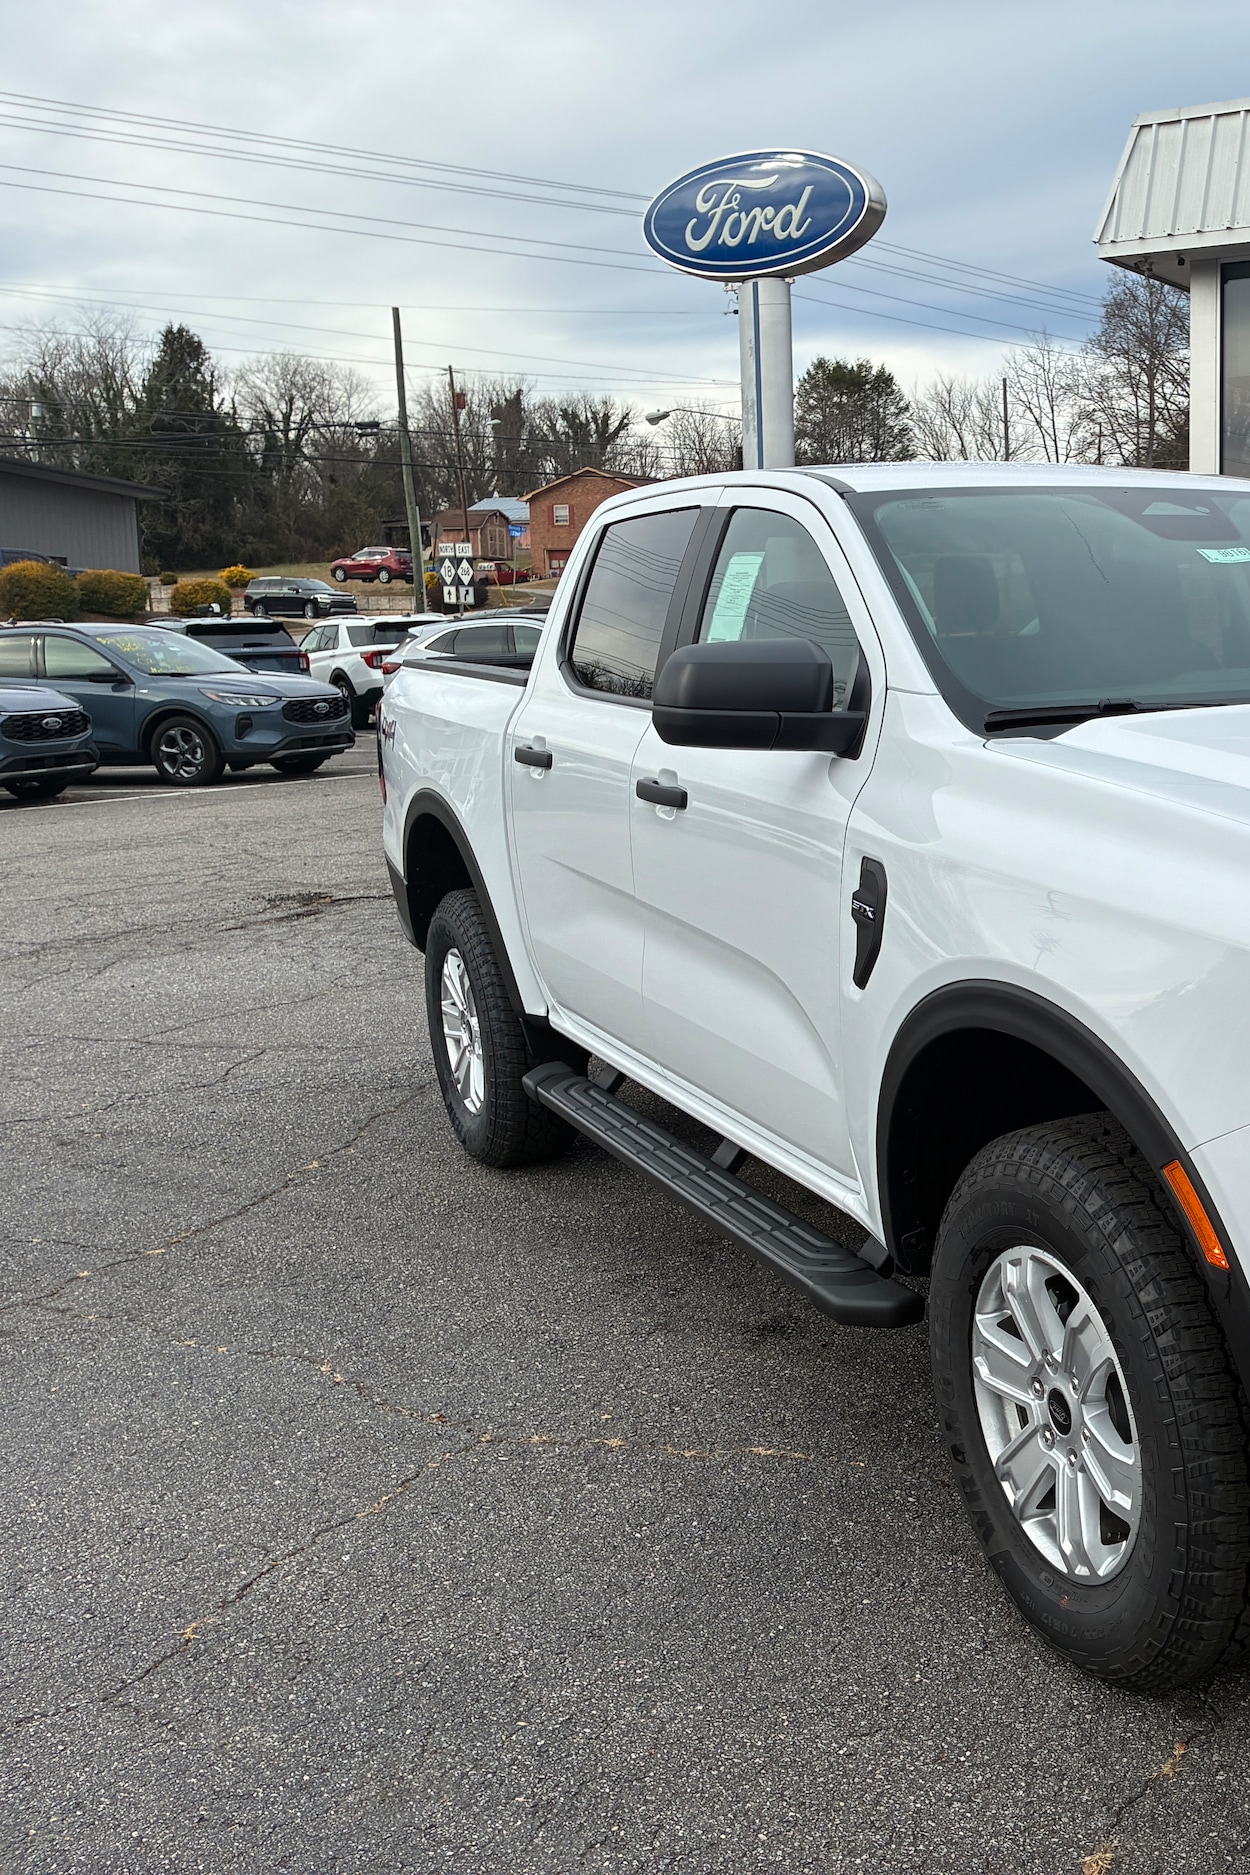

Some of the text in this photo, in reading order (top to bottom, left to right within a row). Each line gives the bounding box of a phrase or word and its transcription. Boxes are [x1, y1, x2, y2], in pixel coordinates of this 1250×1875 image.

[685, 174, 815, 251] Ford
[440, 545, 454, 554] NORTH
[458, 545, 471, 554] EAST
[443, 565, 453, 578] 18
